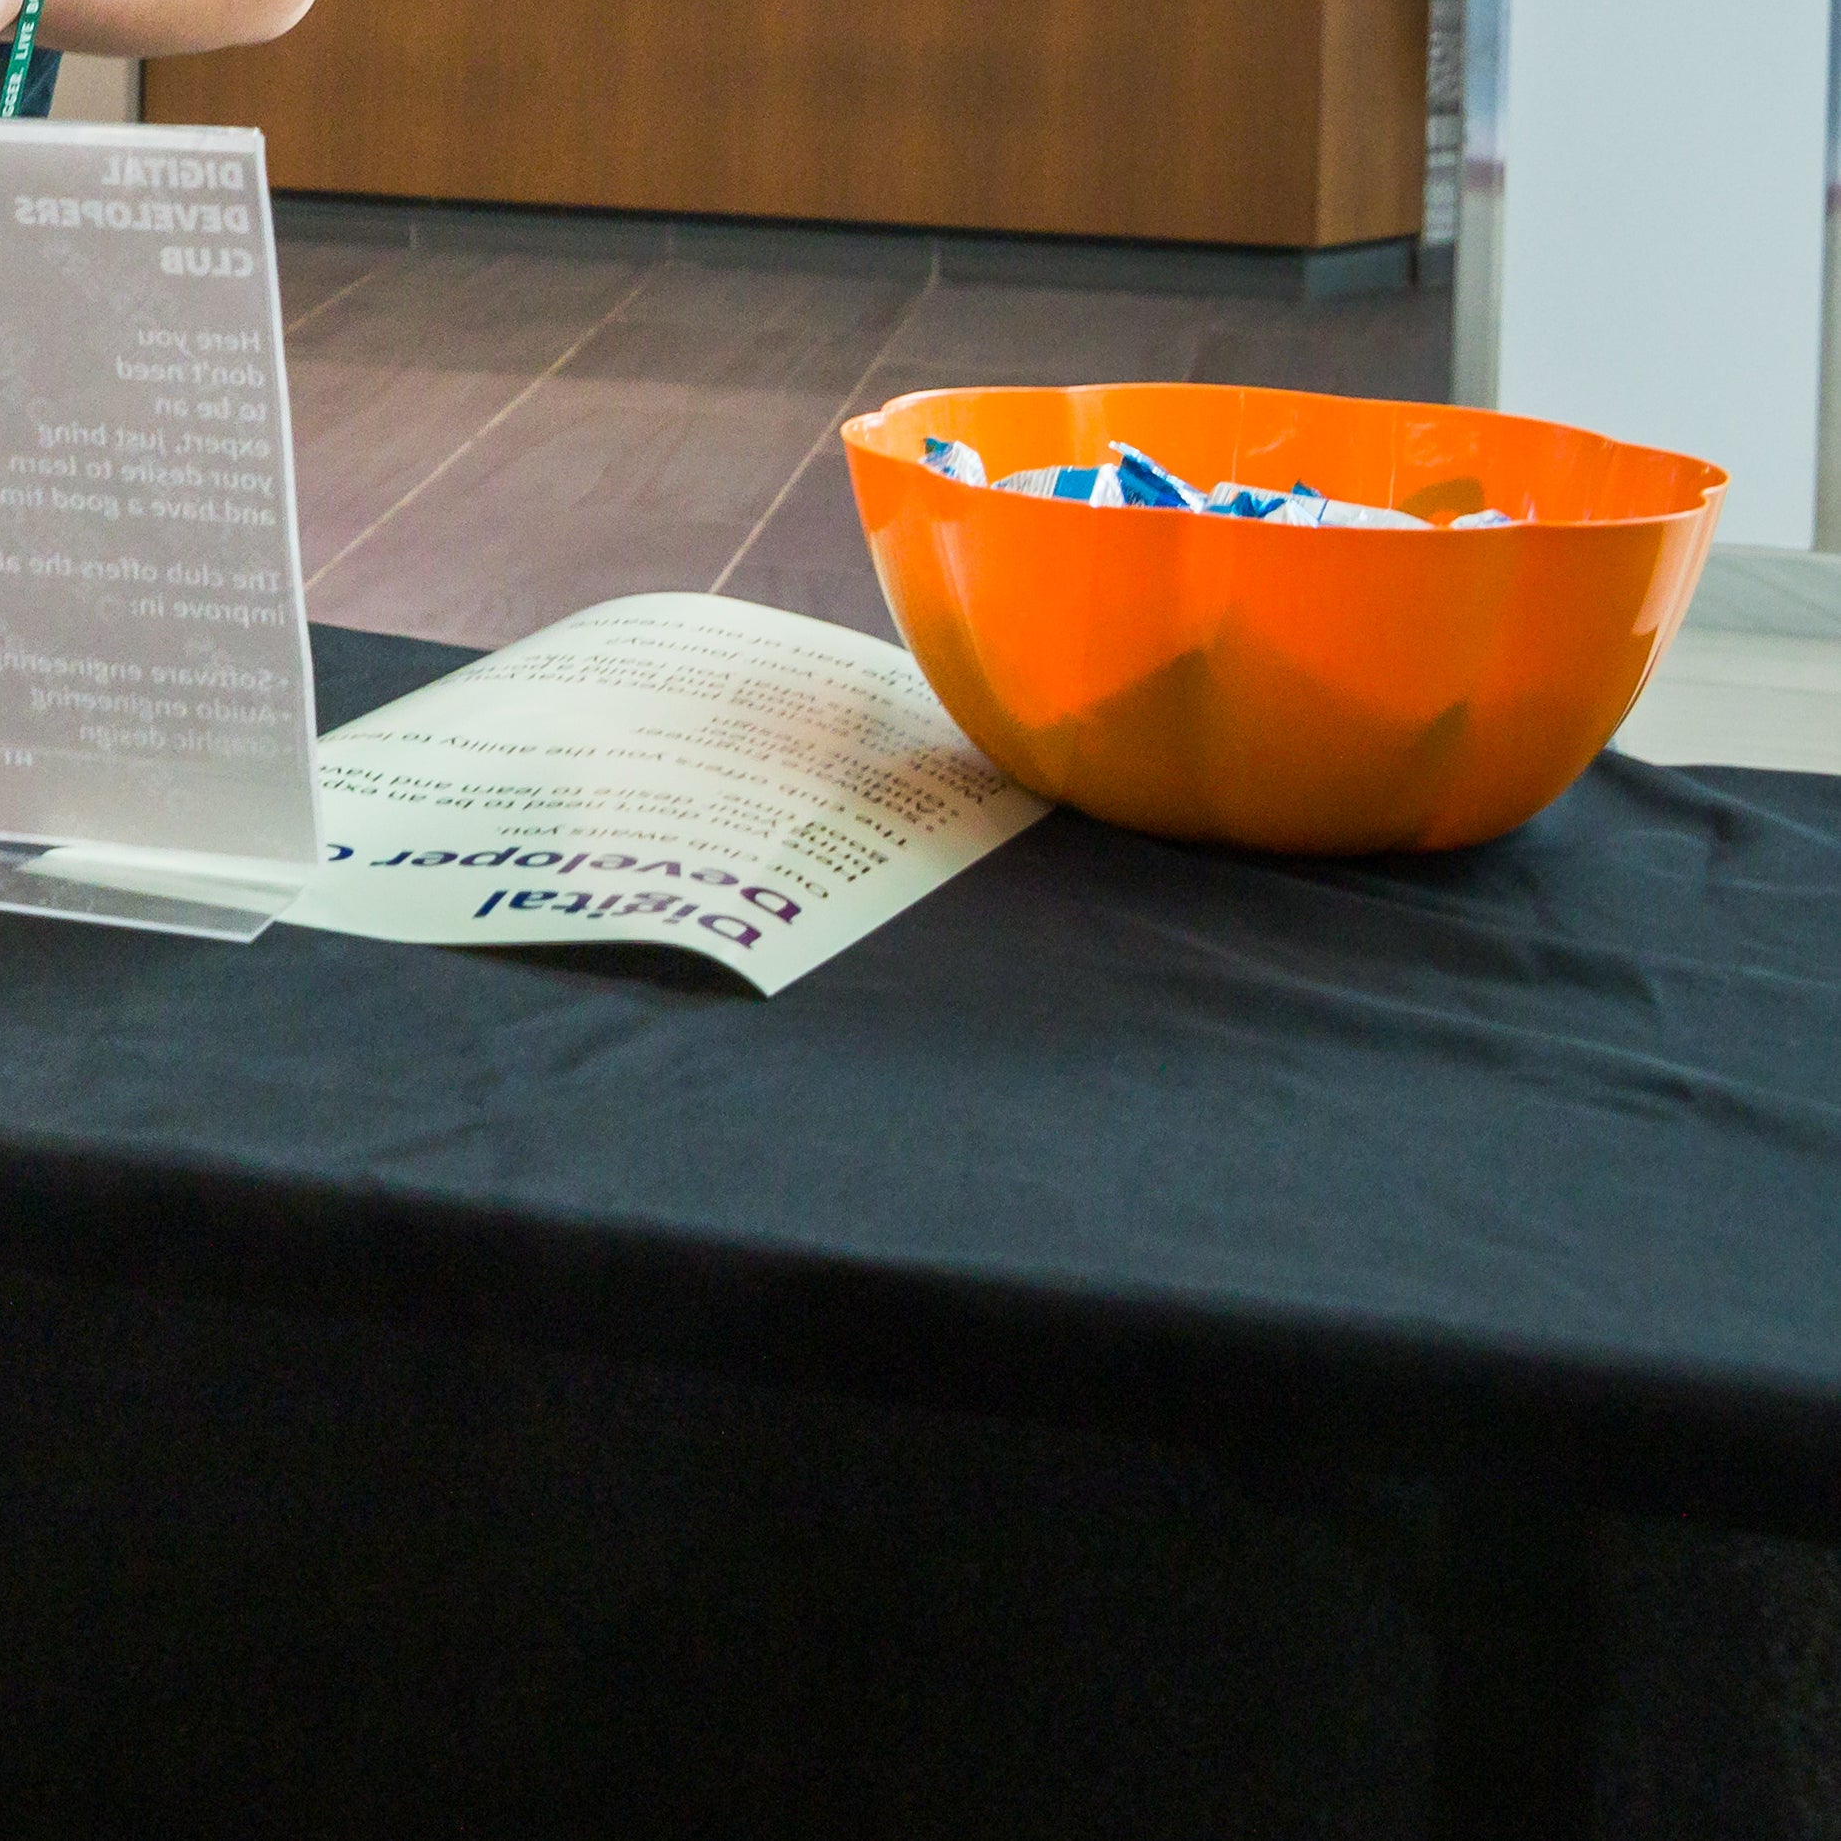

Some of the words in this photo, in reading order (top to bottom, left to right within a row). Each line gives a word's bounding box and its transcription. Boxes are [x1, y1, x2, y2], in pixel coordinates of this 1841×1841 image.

[15, 21, 35, 60] LIVE
[400, 732, 432, 744] to
[438, 735, 538, 754] ability
[544, 746, 597, 758] the
[606, 747, 664, 762] you
[675, 758, 769, 786] offers
[389, 774, 453, 793] and
[460, 782, 543, 799] learn
[551, 786, 584, 799] to
[388, 791, 427, 804] an
[436, 796, 474, 811] be
[483, 798, 516, 810] to
[522, 798, 605, 811] need
[591, 787, 694, 807] desire
[613, 802, 701, 822] don't
[709, 805, 777, 828] your
[569, 826, 679, 847] awaits
[711, 817, 769, 838] you
[856, 813, 907, 847] The
[689, 839, 760, 865] club
[782, 839, 856, 884] Here
[369, 844, 803, 926] Developer
[766, 861, 829, 900] Our
[472, 888, 763, 950] Digital
